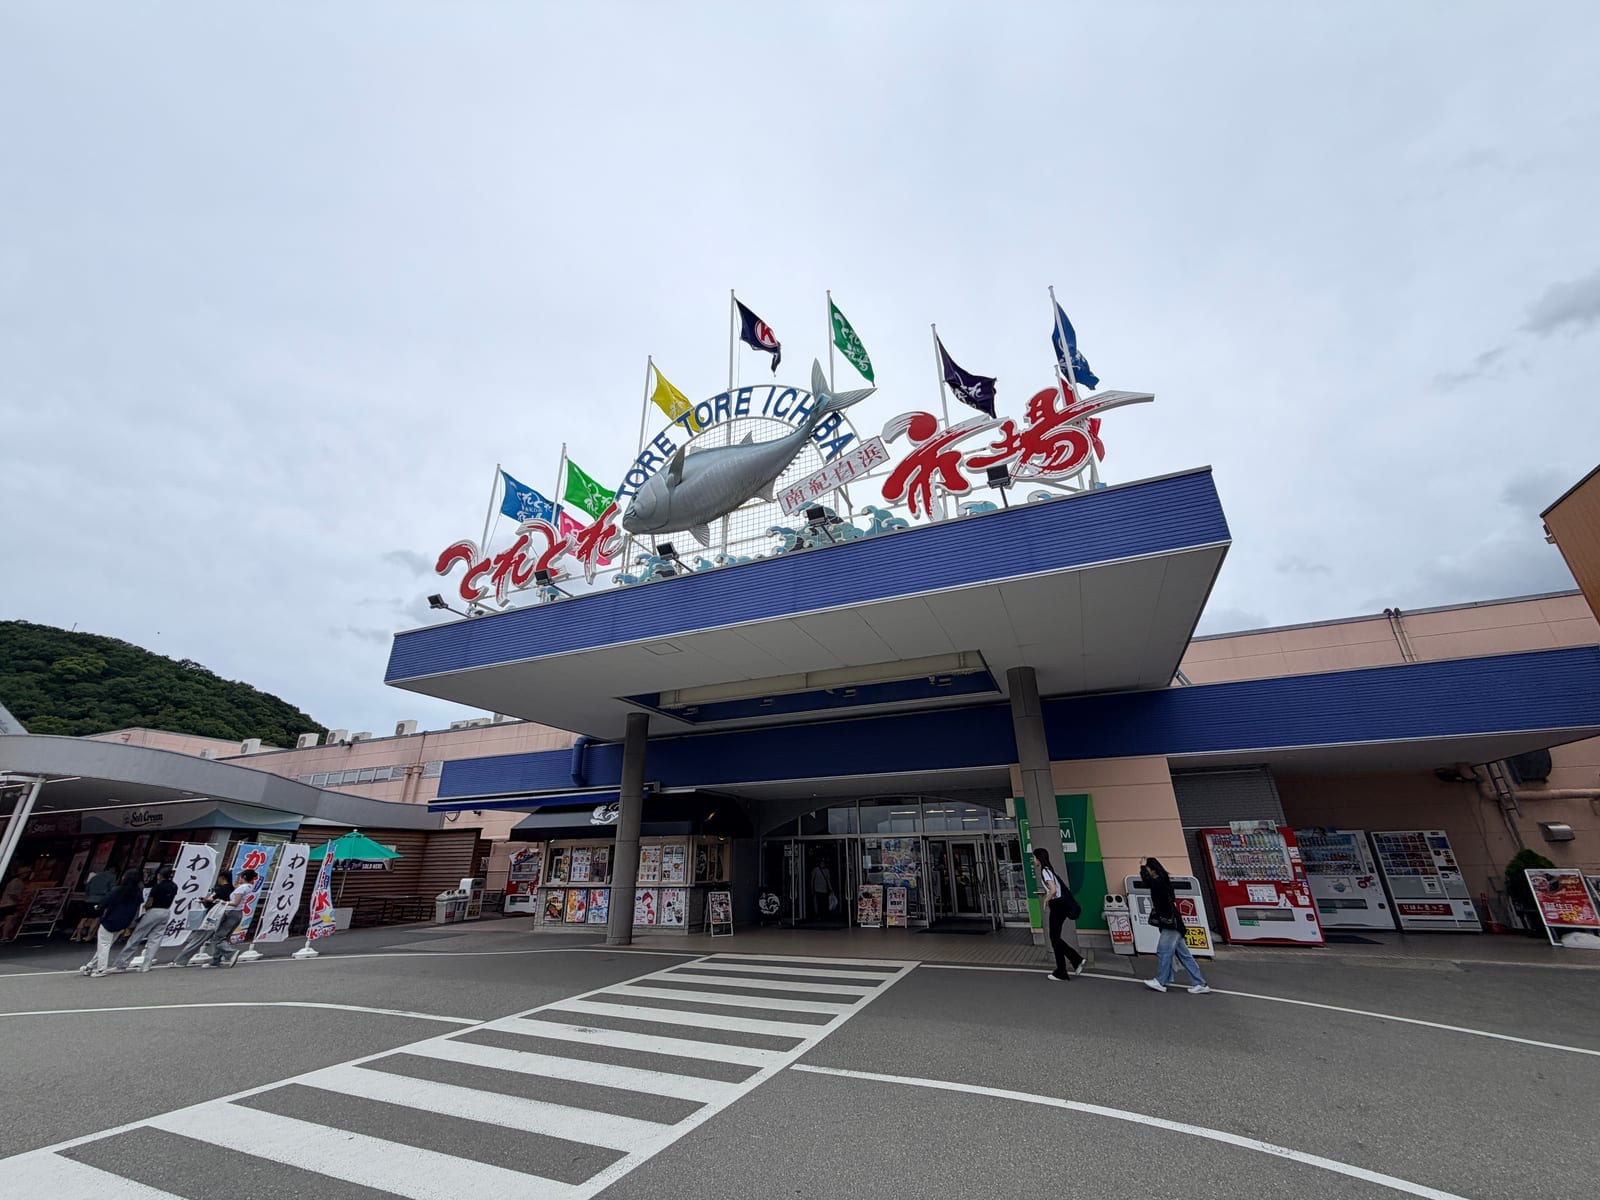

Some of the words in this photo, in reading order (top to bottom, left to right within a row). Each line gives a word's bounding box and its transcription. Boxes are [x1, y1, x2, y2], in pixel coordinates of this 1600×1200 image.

[615, 431, 677, 500] TORE
[676, 386, 753, 437] TORE
[762, 385, 856, 462] ICHBA
[785, 443, 882, 509] 南紀白浜
[881, 386, 1155, 521] 市場
[163, 853, 210, 938] わらび餅
[268, 853, 305, 934] わらび餅
